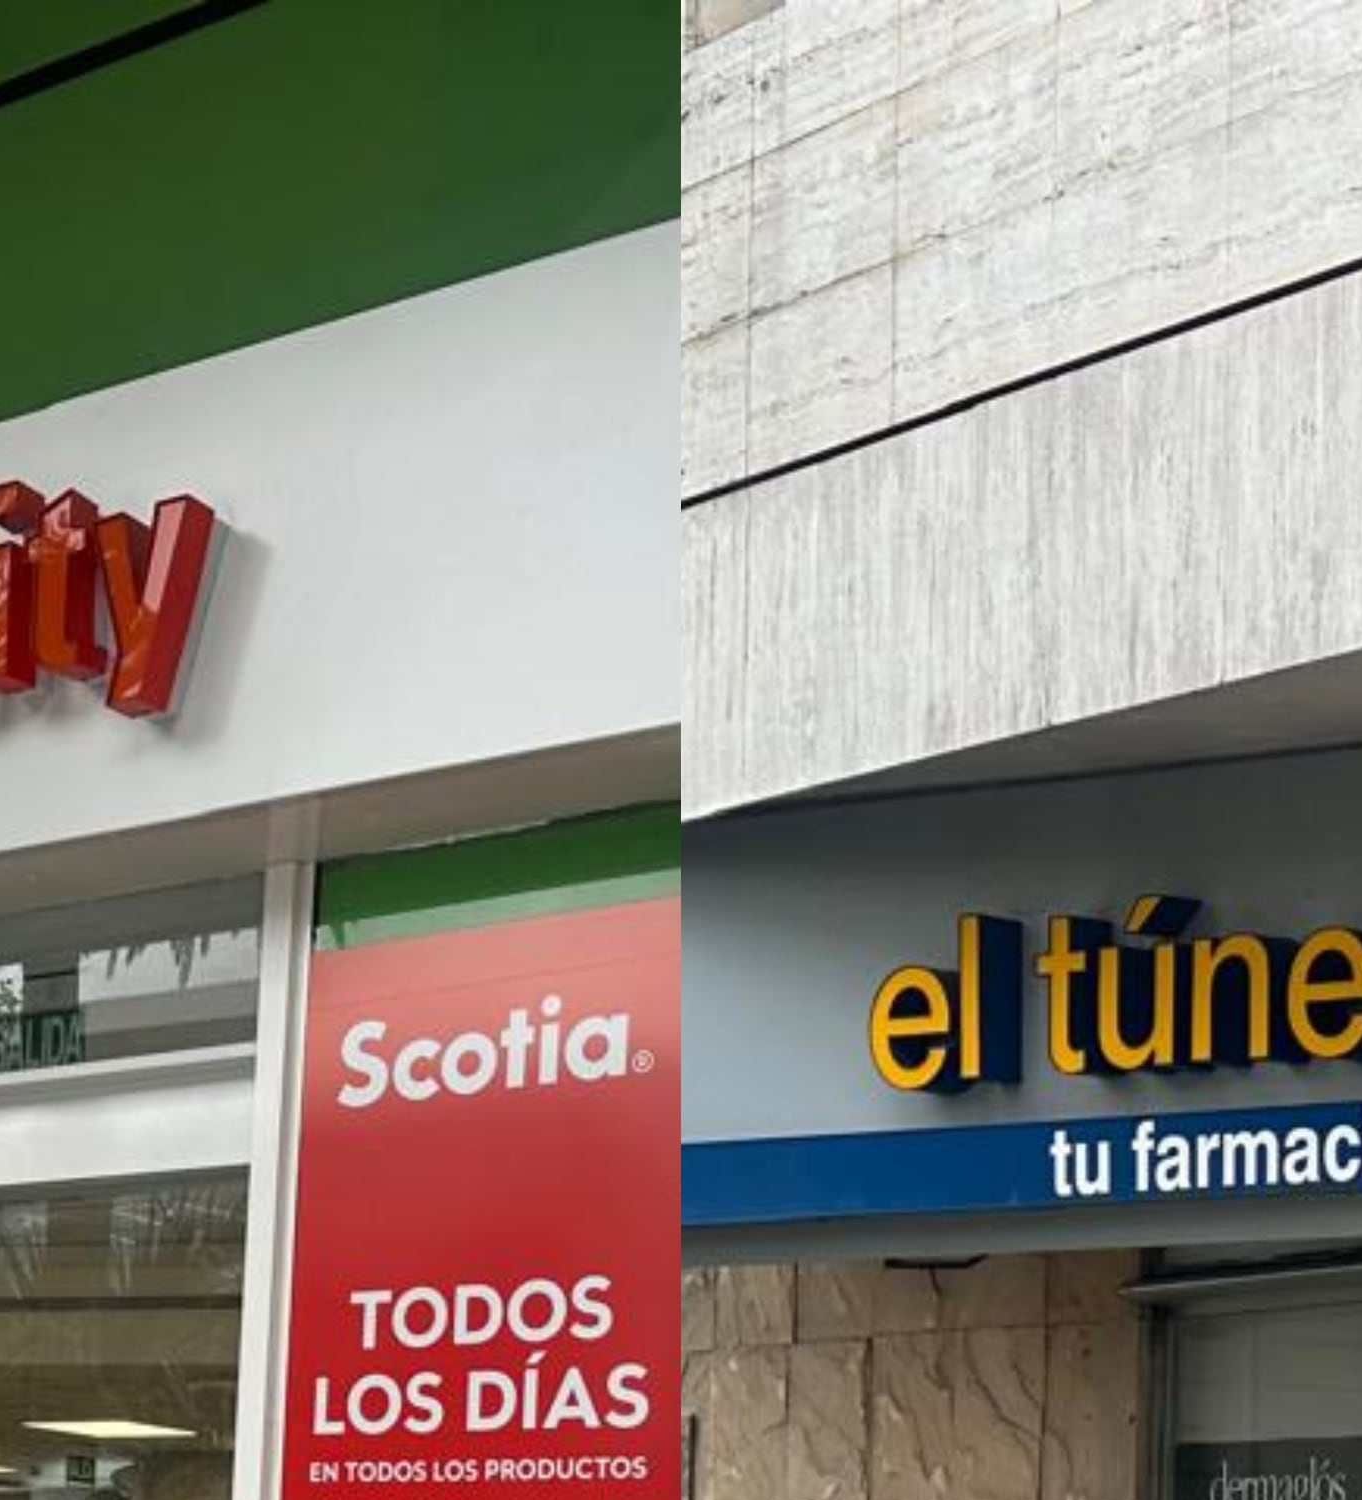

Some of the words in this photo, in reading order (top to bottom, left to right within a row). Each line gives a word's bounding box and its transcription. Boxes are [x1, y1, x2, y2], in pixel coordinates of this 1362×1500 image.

[867, 911, 1021, 1094] el
[1049, 1128, 1113, 1200] tu
[351, 1275, 614, 1350] TODOS
[313, 1372, 444, 1436] LOS
[466, 1352, 651, 1432] DÍAS
[309, 1461, 338, 1483] EN
[344, 1460, 427, 1483] TODOS
[432, 1459, 478, 1482] LOS
[485, 1456, 648, 1481] PRODUCTOS
